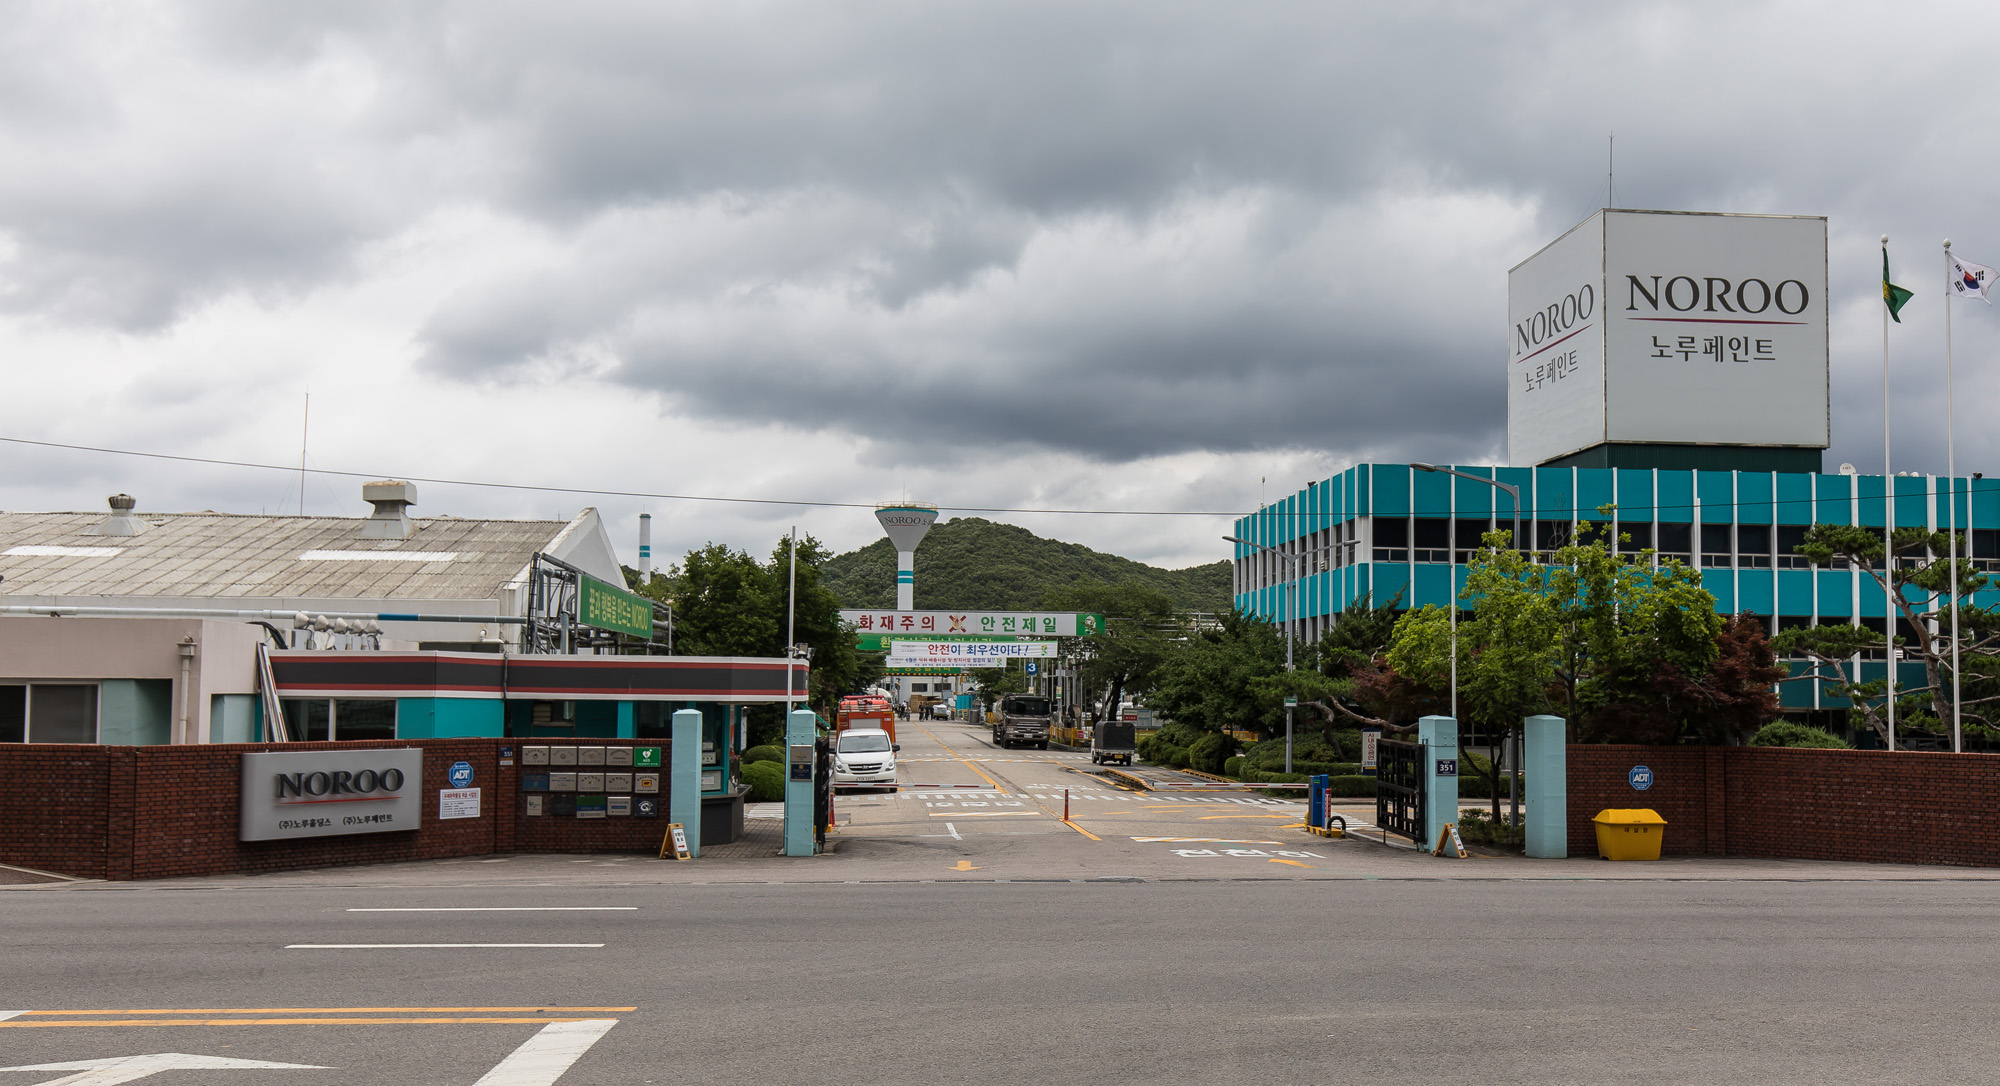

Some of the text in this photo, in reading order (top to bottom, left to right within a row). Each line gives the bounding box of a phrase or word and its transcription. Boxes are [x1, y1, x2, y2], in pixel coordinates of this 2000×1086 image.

[1626, 275, 1809, 314] NOROO
[1516, 284, 1594, 356] NOROO
[1651, 336, 1776, 362] 노루페인트
[1525, 349, 1578, 393] 노루페인트
[884, 516, 921, 524] NOROO
[590, 588, 648, 630] 꿈과 행복을 만드는 NOROO
[859, 614, 1057, 633] 화재주의 안전제일
[928, 644, 1029, 656] 안전이 최우선이다!
[276, 768, 404, 798] NOROO
[453, 770, 470, 780] ADT
[1633, 774, 1649, 782] ADT
[278, 814, 394, 830] (주)노루홀딩스 (주)노루페인트
[1169, 848, 1328, 859] 천천히
